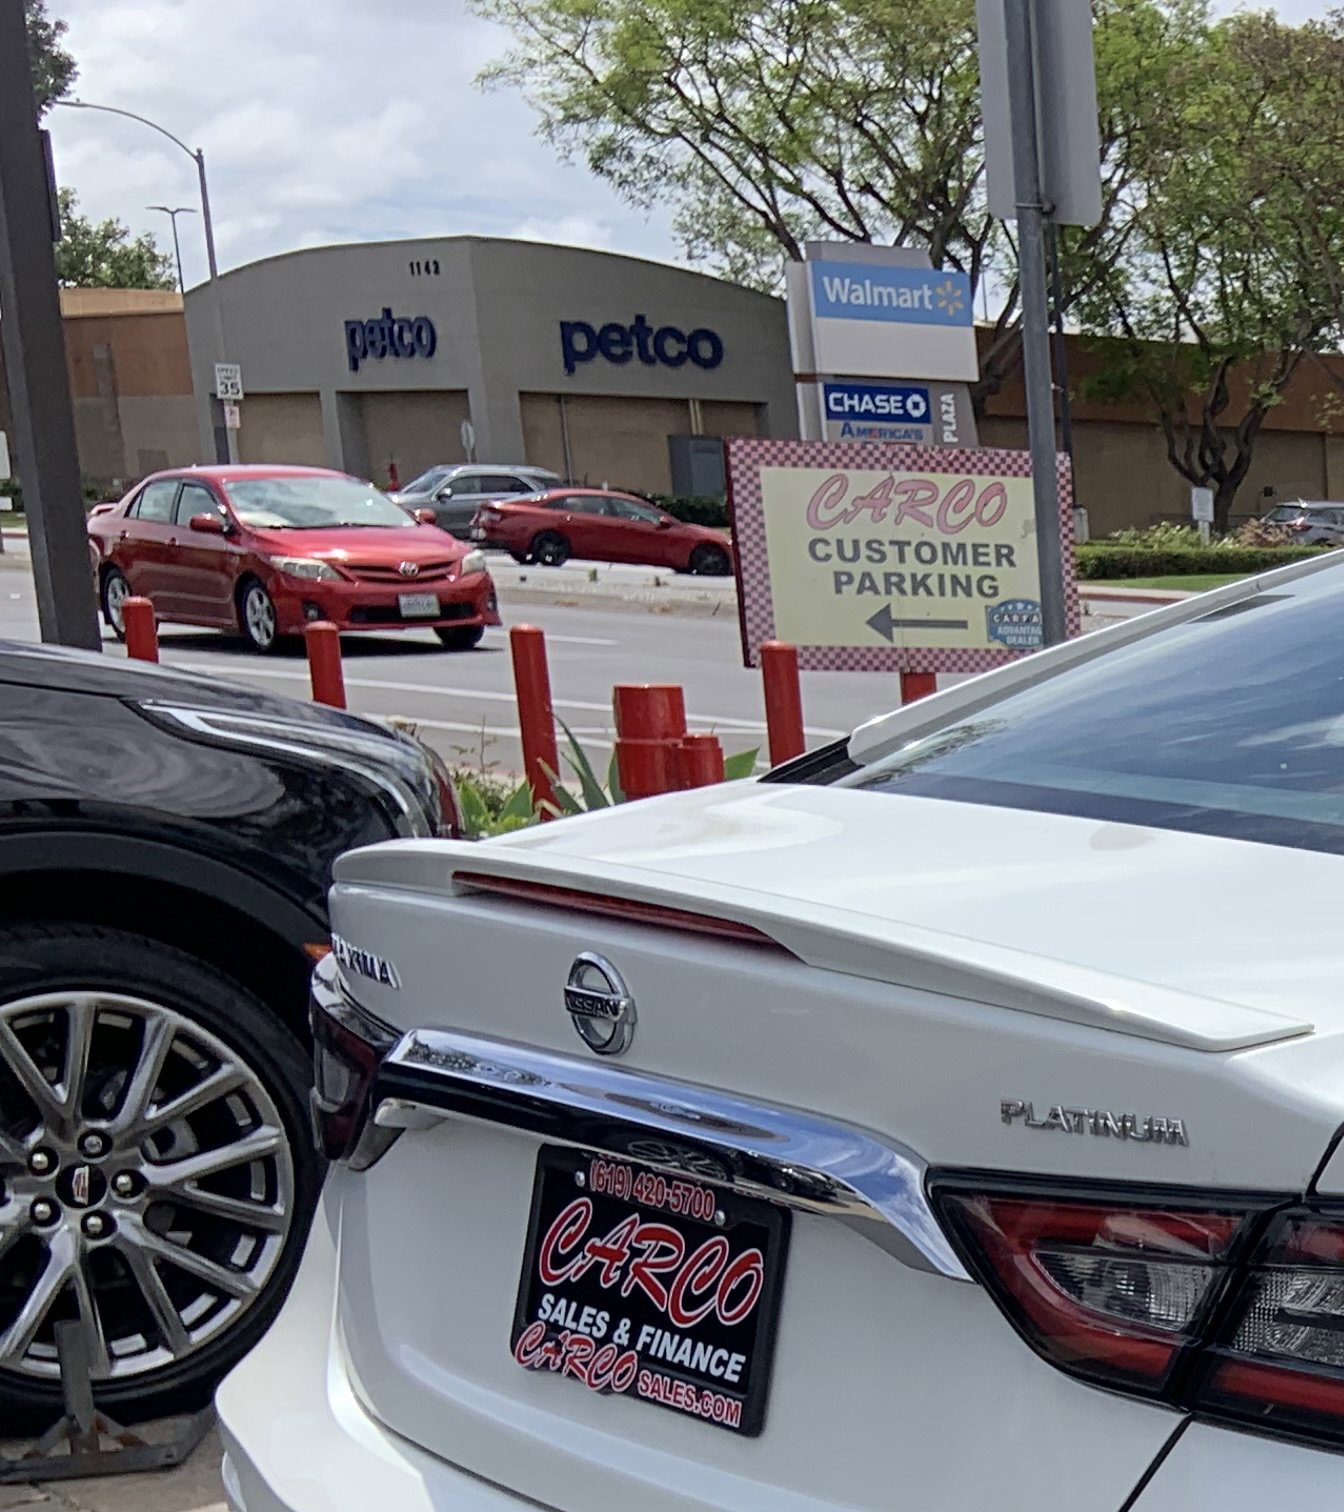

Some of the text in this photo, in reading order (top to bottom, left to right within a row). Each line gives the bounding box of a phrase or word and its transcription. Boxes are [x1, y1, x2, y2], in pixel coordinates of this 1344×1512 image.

[823, 276, 933, 310] Walmart
[344, 307, 437, 373] petco
[560, 313, 724, 376] petco
[219, 382, 240, 395] 35
[828, 392, 904, 414] CHASE
[940, 393, 959, 443] PLAZA
[806, 473, 1008, 535] CARCO
[808, 538, 1017, 568] CUSTOMER
[833, 571, 999, 598] PARKING
[1000, 1099, 1189, 1147] PLATINUM
[590, 1160, 632, 1199] (619)
[539, 1197, 763, 1328] CARCO
[538, 1293, 746, 1383] SALES & FINANCE
[515, 1321, 742, 1428] CARCO SALES.COM
